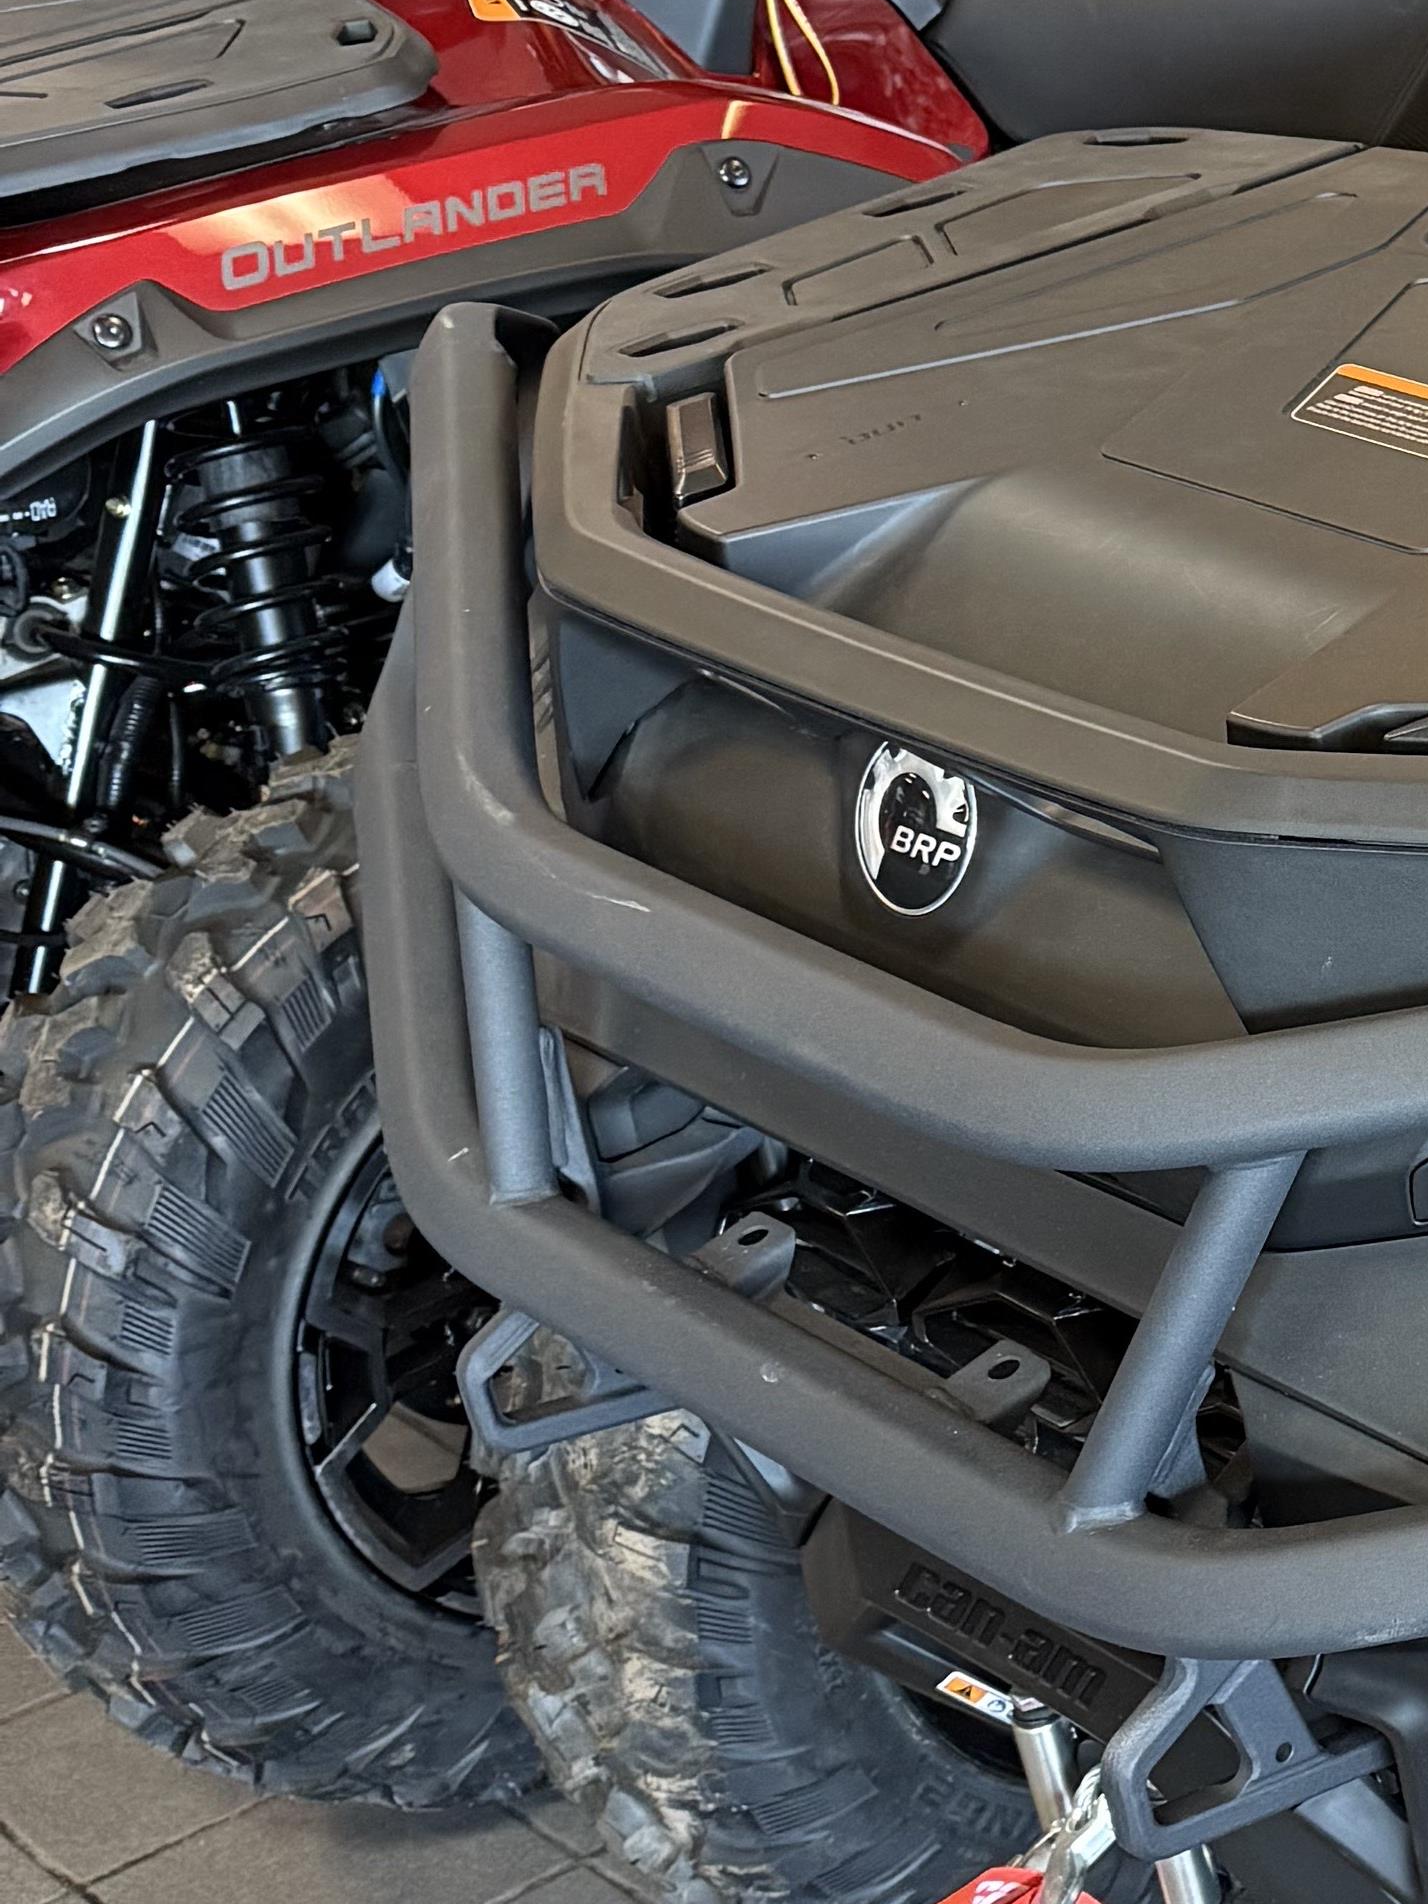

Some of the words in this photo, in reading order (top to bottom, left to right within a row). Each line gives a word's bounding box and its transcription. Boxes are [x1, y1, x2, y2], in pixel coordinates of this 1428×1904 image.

[220, 163, 607, 291] OUTLANDER
[891, 825, 961, 867] BRP
[898, 1566, 1107, 1709] can-am
